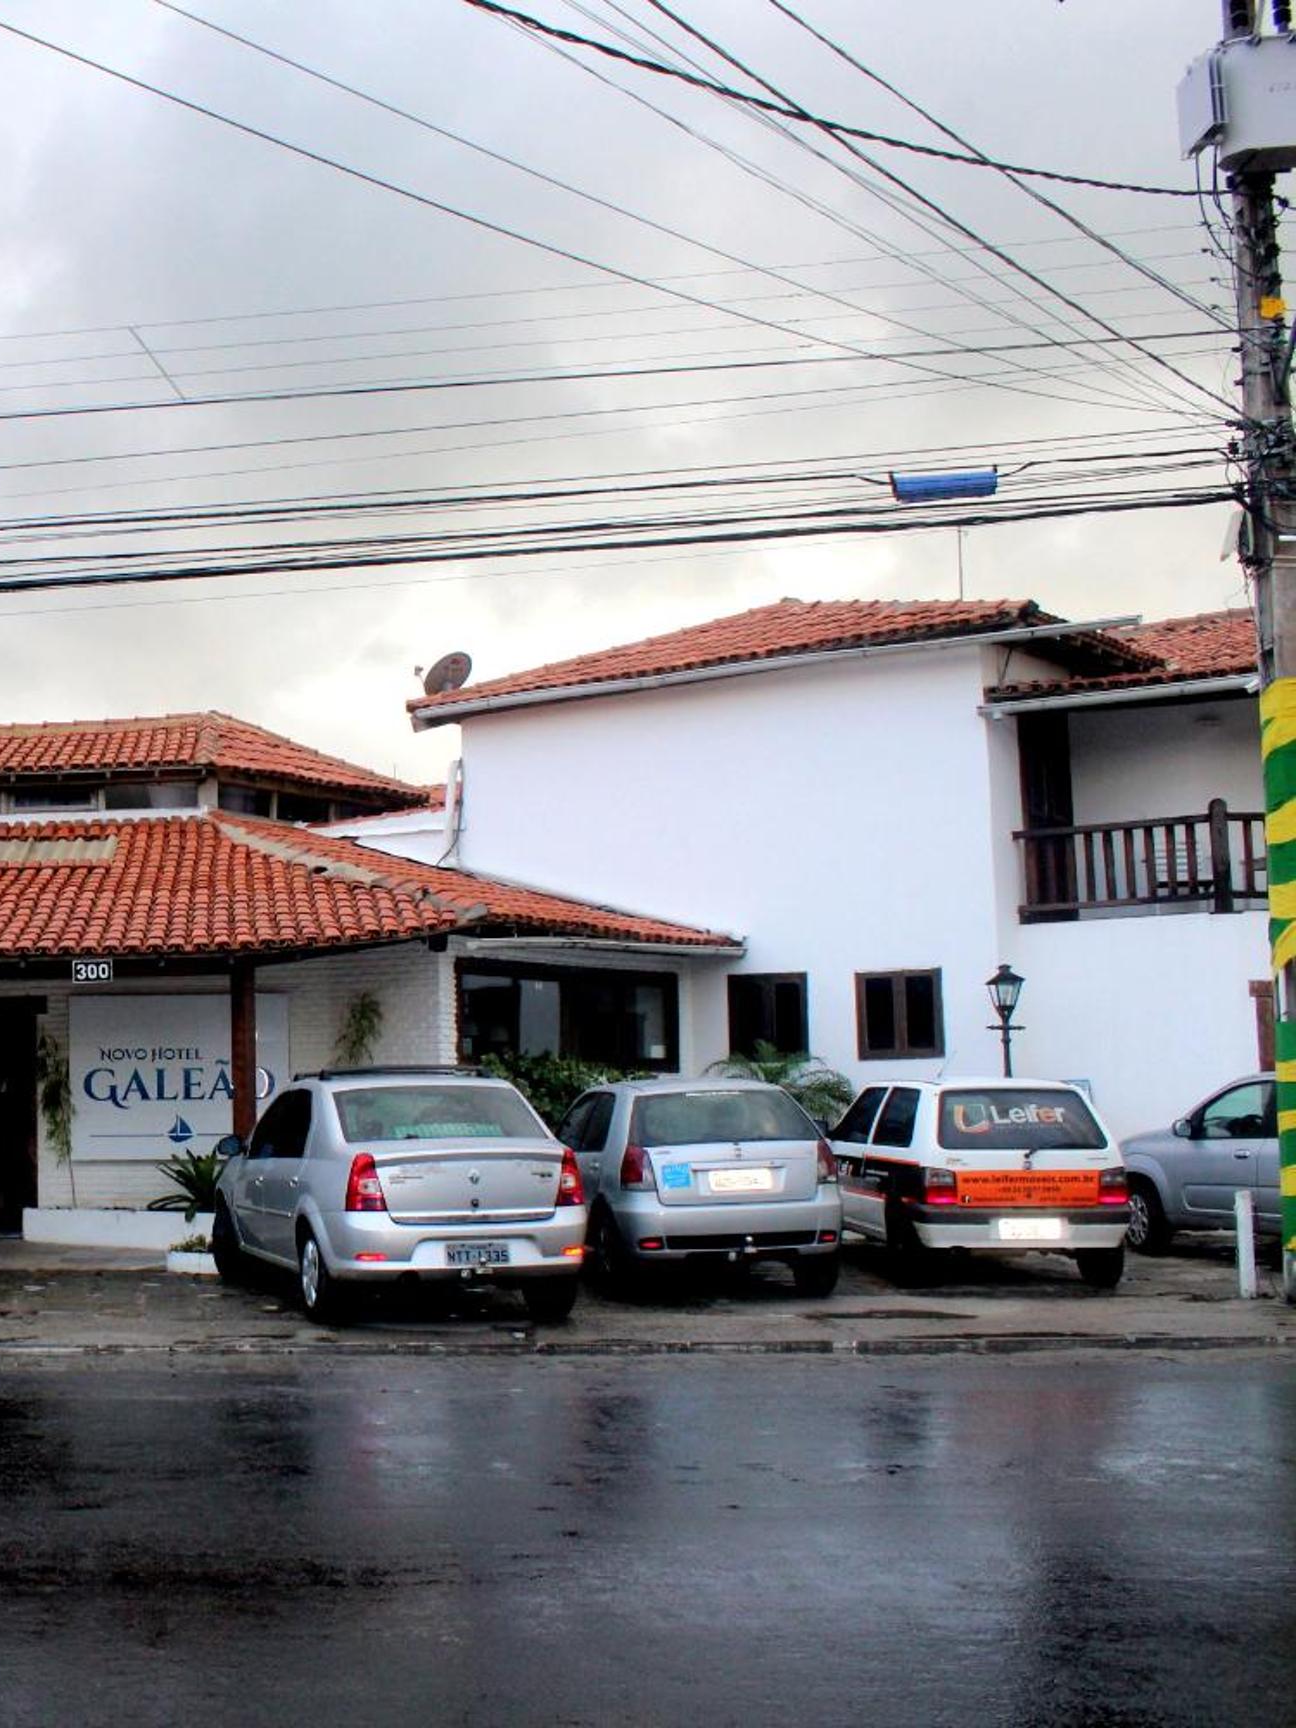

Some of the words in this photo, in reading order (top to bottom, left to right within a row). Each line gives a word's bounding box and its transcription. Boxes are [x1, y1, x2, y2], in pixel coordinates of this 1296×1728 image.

[76, 963, 110, 980] 300
[99, 1045, 147, 1062] NOVO
[151, 1046, 203, 1062] HOTEL
[990, 1103, 1065, 1124] Leifer
